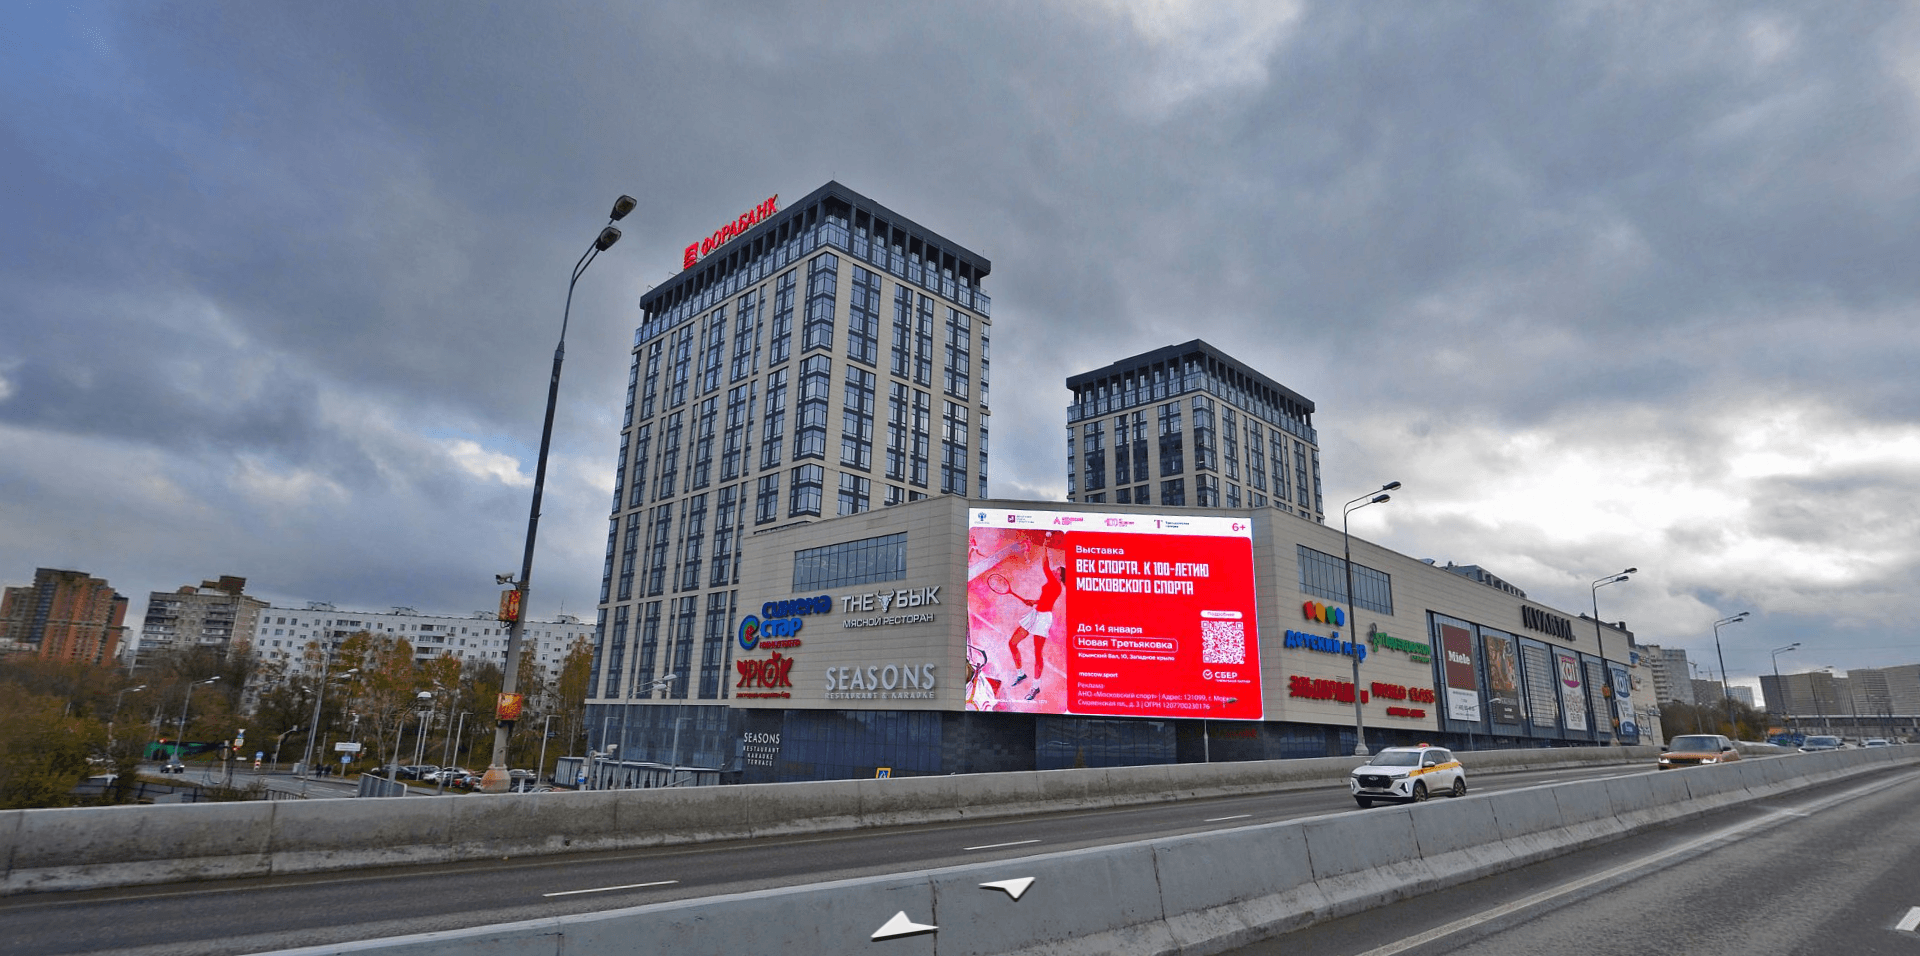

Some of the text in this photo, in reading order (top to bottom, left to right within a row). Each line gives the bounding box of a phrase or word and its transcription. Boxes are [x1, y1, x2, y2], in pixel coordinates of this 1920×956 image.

[701, 194, 778, 256] ФОРАБАНК
[1231, 522, 1246, 532] 6+
[1075, 545, 1125, 555] Выставка
[1076, 559, 1209, 577] ВЕК СПОРТА. К 100-ЛЕТИЮ
[1076, 577, 1194, 595] МОСКОВСКОГО СПОРТА
[841, 585, 941, 613] THE БЫК
[843, 613, 934, 628] МЯСНОЙ РЕСТОРАН
[1521, 604, 1577, 642] KVARTAL
[1077, 623, 1143, 634] До 14 января
[1077, 637, 1173, 649] Новая Третьяковка
[1448, 650, 1471, 665] Miele
[737, 657, 793, 688] УРЮК
[825, 663, 935, 691] SEASONS
[1078, 671, 1118, 679] moscow.sport
[1214, 671, 1238, 679] СБЕР
[824, 692, 878, 700] RESTAURANT
[891, 691, 935, 699] KARAOKE
[744, 732, 780, 744] SEASONS
[743, 745, 779, 753] RESTAURANT
